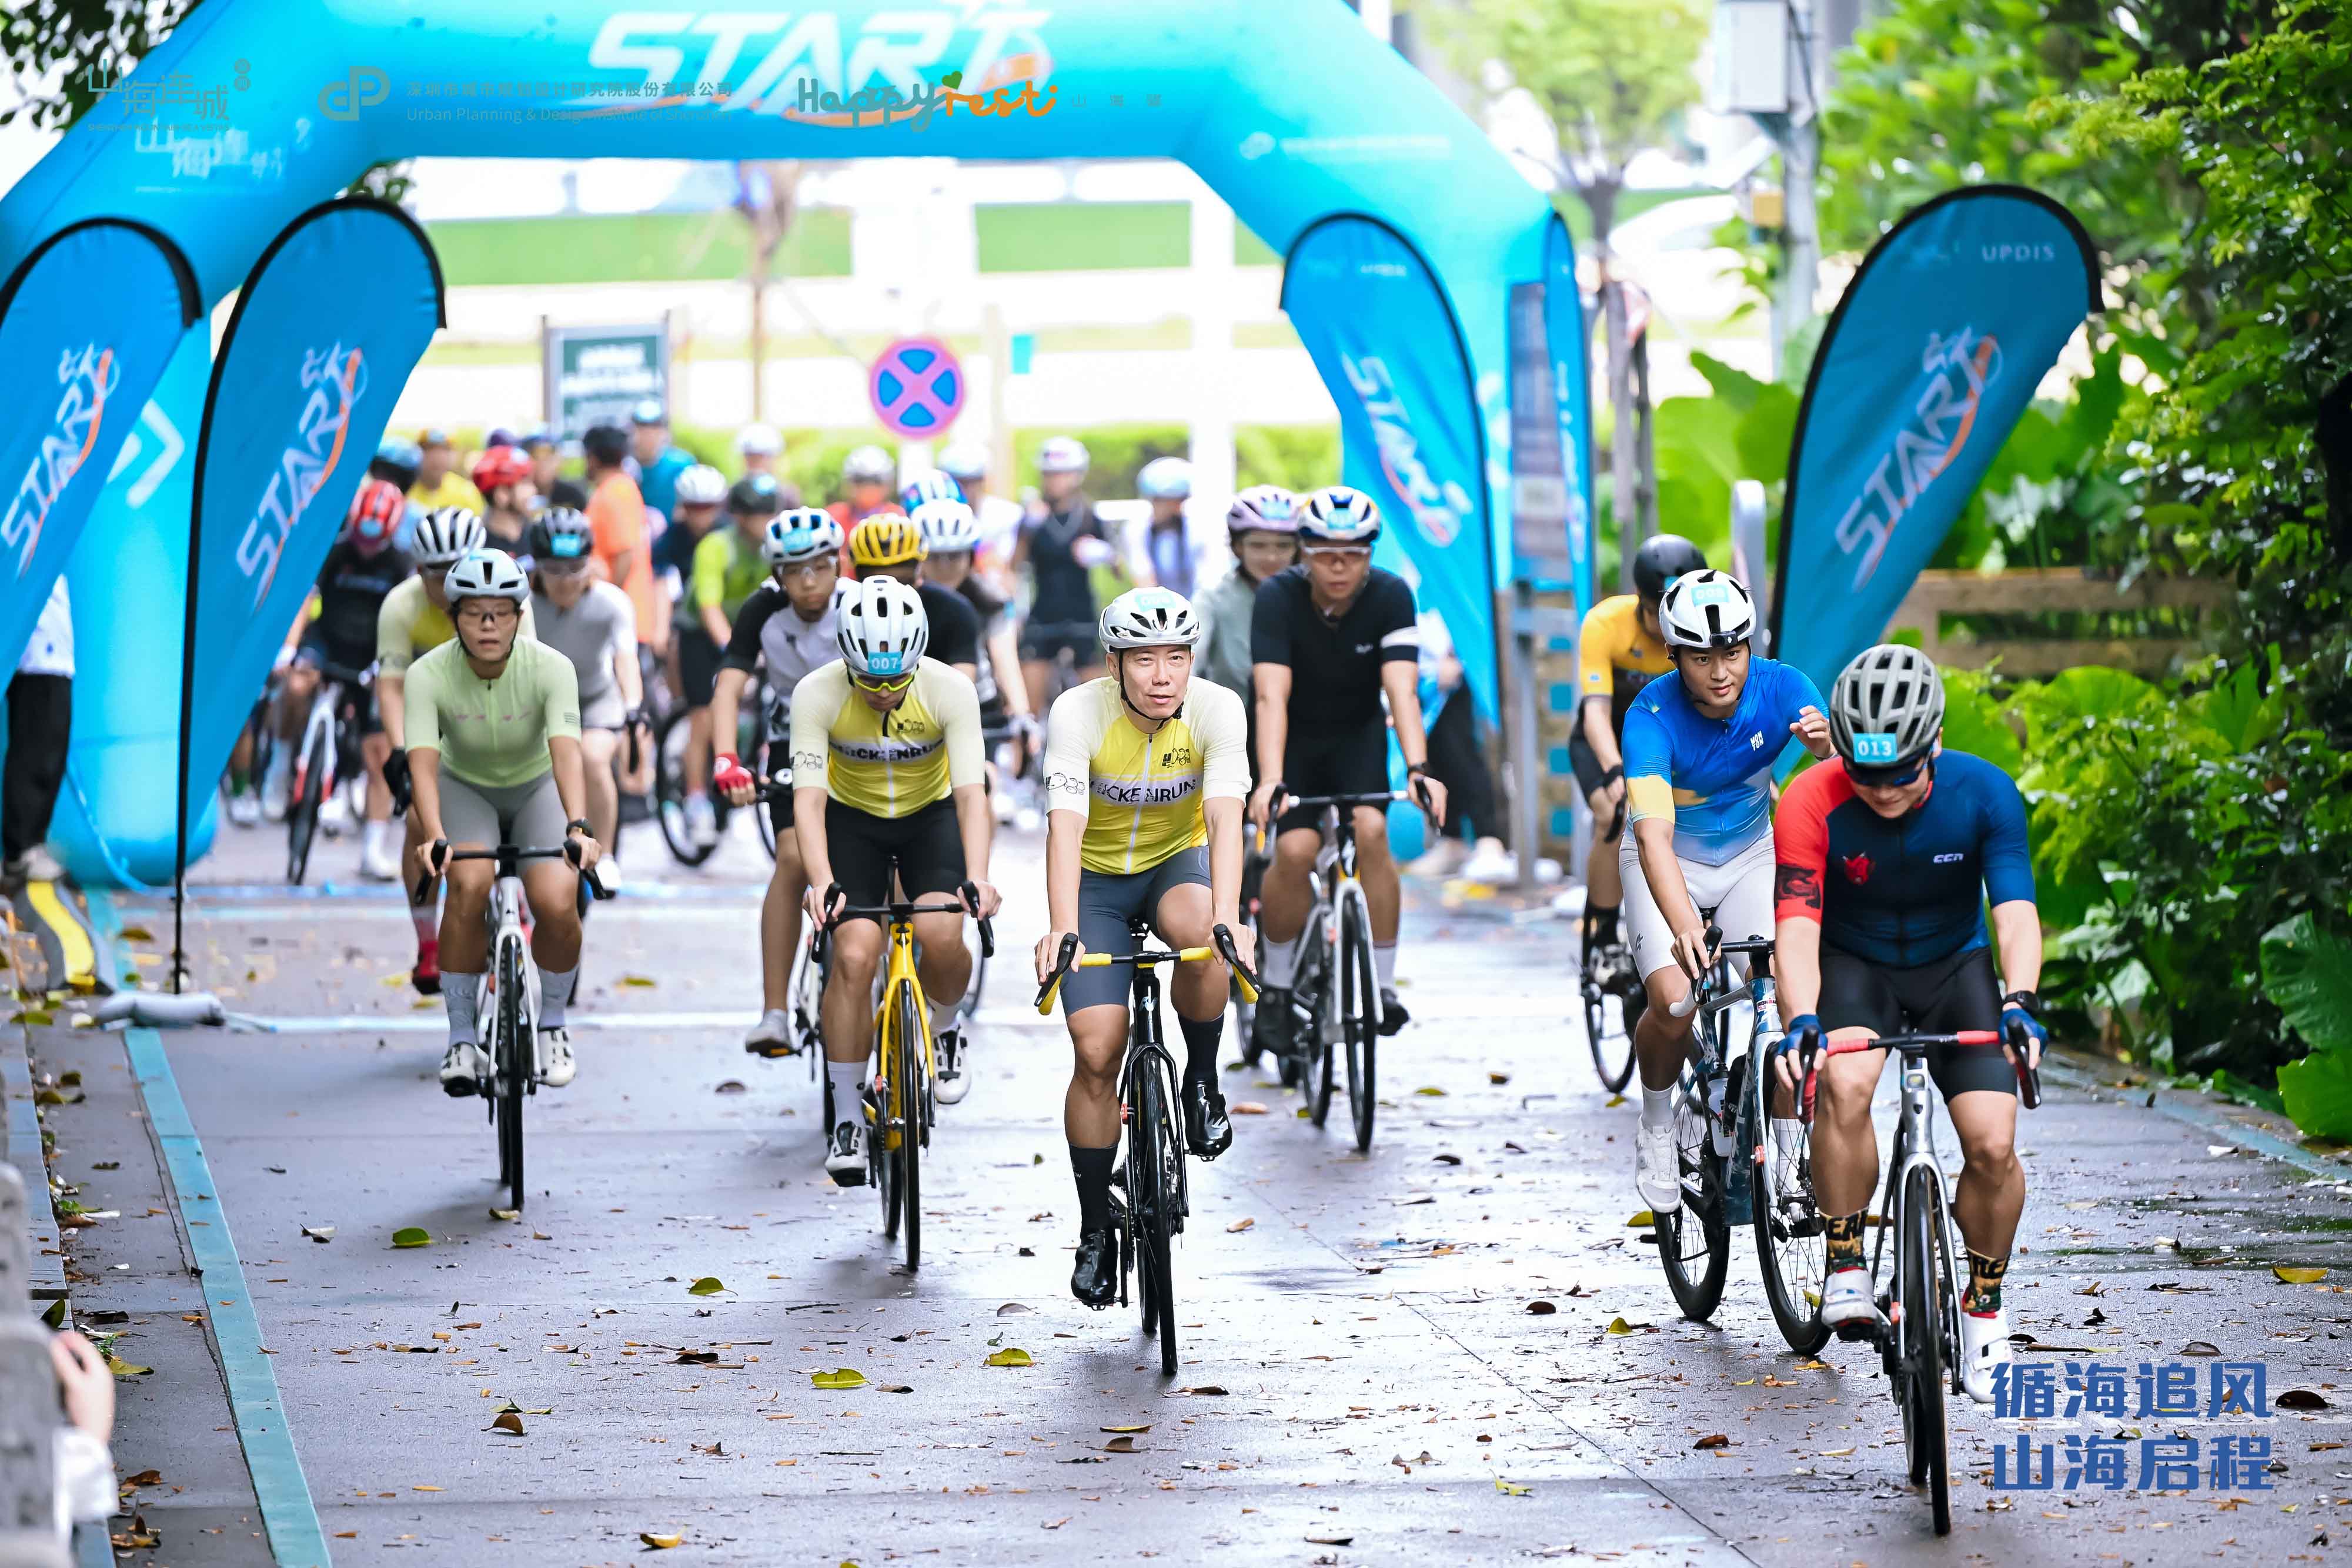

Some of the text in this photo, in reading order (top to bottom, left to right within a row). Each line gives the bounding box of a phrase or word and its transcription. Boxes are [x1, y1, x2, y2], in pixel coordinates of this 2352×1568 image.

[589, 9, 1055, 116] START
[1982, 244, 2055, 262] UPDIS
[1, 343, 110, 579] START
[237, 341, 356, 611] START
[1835, 326, 1985, 594] START
[871, 657, 898, 670] 007
[1858, 740, 1892, 757] 013
